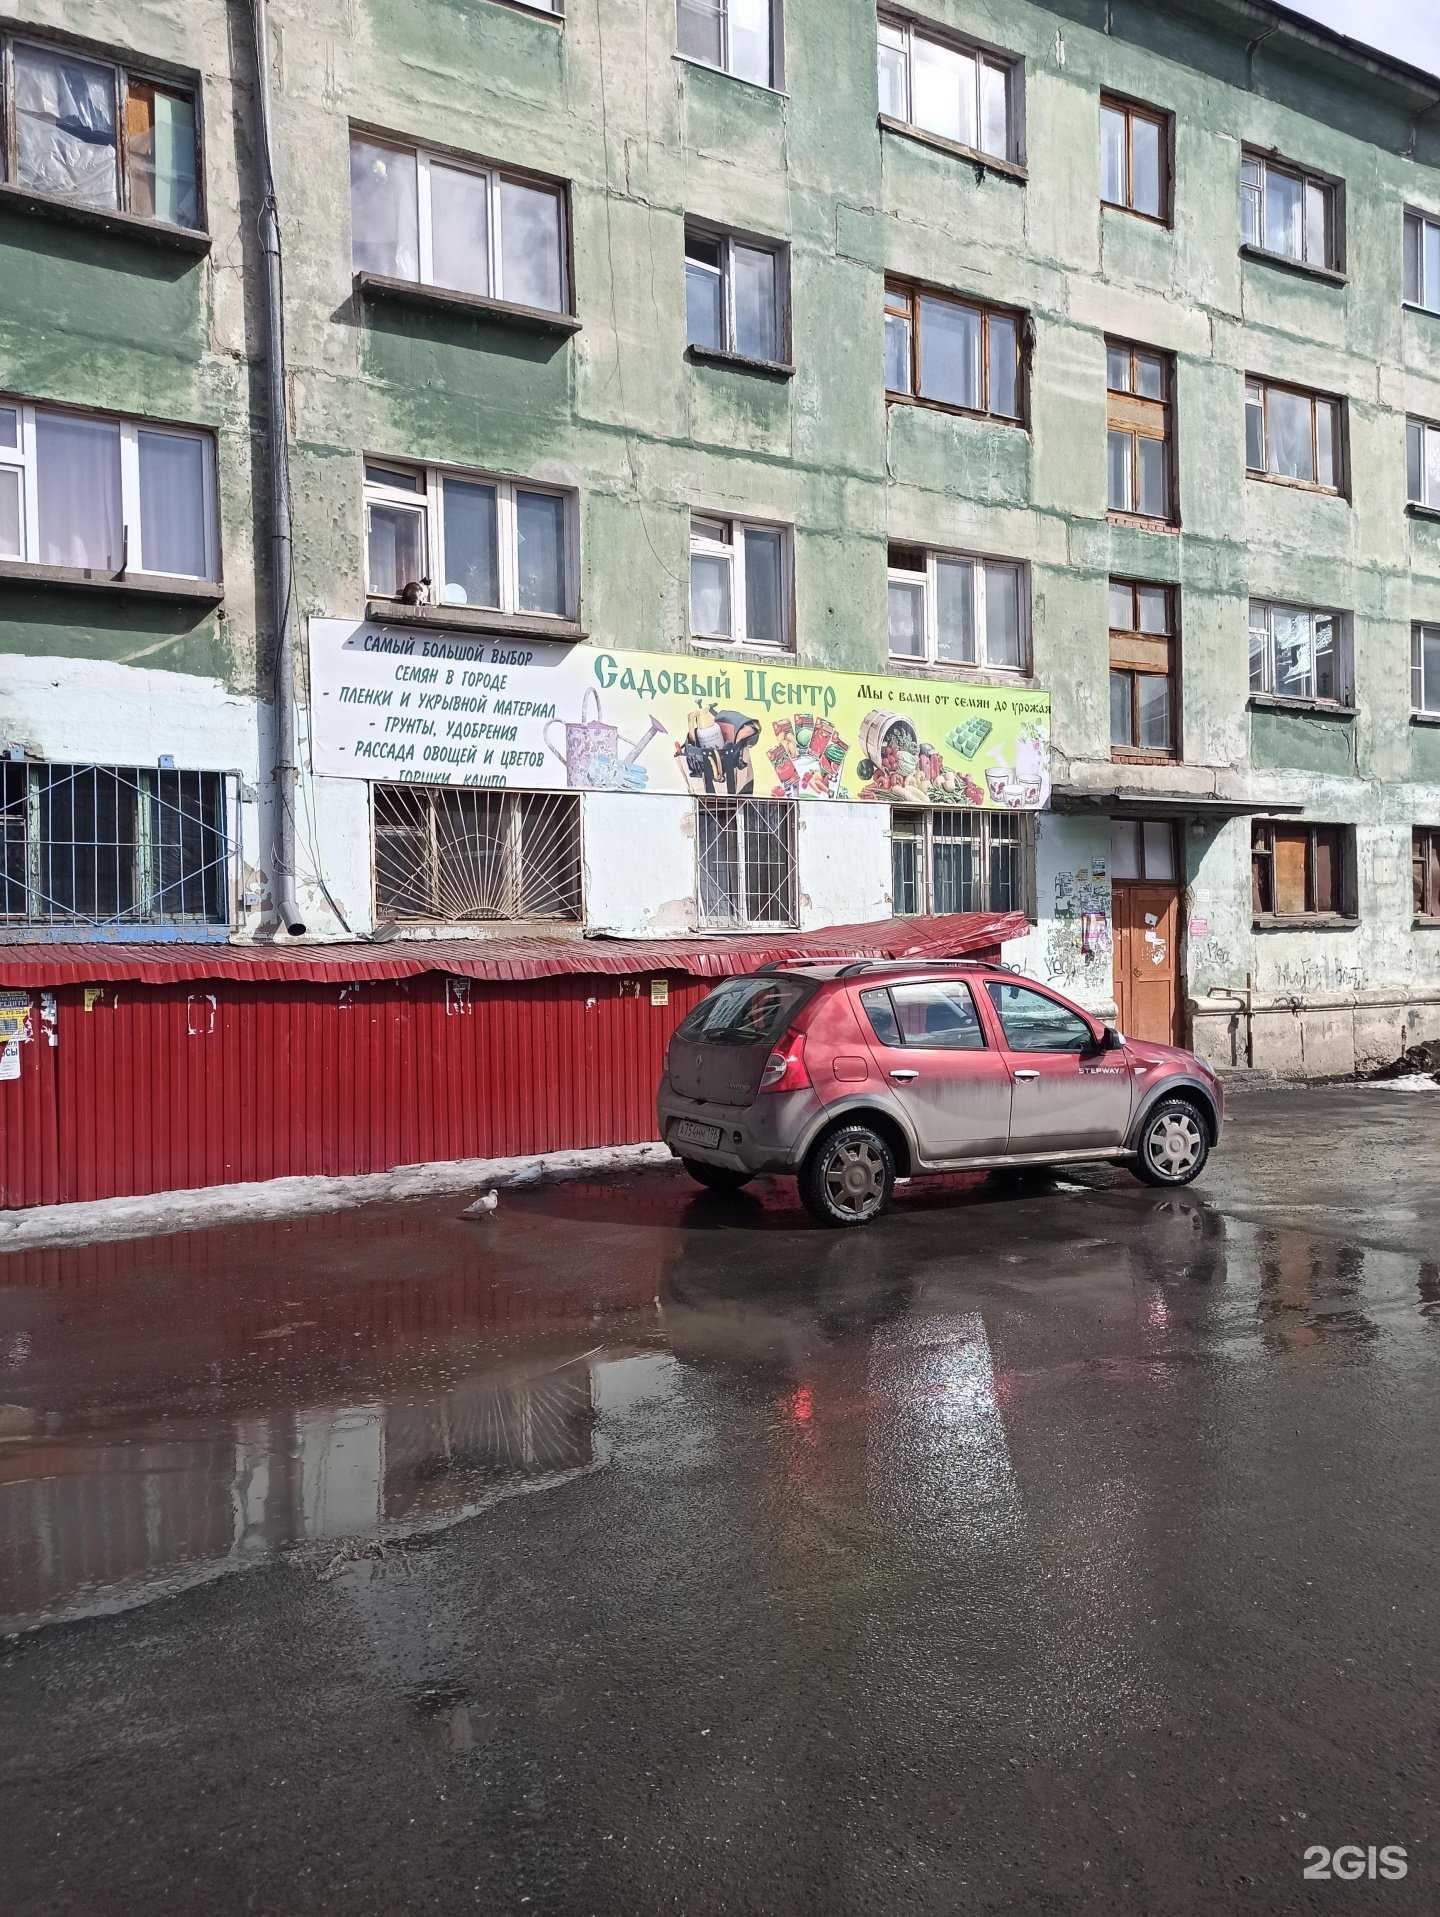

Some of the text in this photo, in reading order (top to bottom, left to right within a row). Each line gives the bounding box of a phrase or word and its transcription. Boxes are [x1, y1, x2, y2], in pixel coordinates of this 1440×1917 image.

[363, 635, 416, 656] САМЫЙ
[422, 641, 485, 663] БОЛЬШОЙ
[491, 648, 533, 666] ВЫБОР
[395, 664, 508, 691] СЕМЯН В ГОРОДЕ
[594, 654, 837, 717] Садовый Центр
[339, 686, 393, 706] ПЛЕНКИ
[399, 691, 411, 708] И
[418, 692, 487, 714] УКРЫВНОЙ
[493, 699, 556, 719] МАТЕРИАЛ
[857, 684, 1052, 716] Мы с вами от семян до урожая
[384, 716, 437, 737] ГРУНТЫ,
[445, 720, 518, 742] УДОБРЕНИЯ
[354, 740, 415, 762] РАССАДА
[423, 744, 478, 766] ОВОЩЕЙ
[483, 750, 494, 765] И
[500, 750, 545, 769] ЦВЕТОВ
